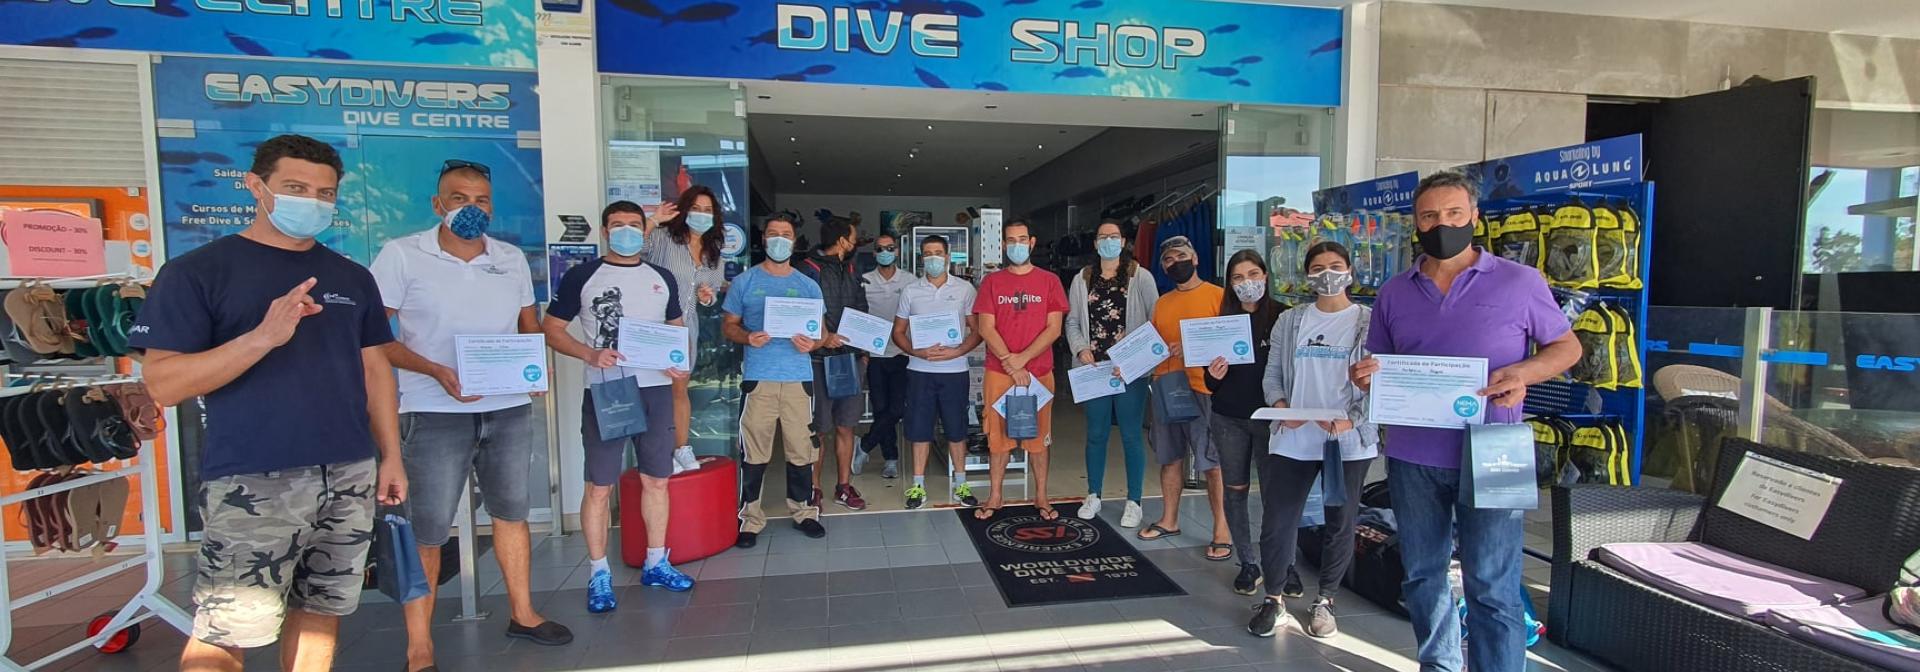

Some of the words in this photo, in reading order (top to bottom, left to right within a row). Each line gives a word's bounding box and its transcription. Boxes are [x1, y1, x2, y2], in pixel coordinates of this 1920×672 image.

[777, 4, 959, 58] DIVE
[1011, 18, 1207, 69] SHOP
[205, 73, 511, 110] EASYDIVERS
[343, 110, 400, 127] DIVE
[411, 112, 510, 129] CENTRE
[1535, 169, 1568, 184] AQUA
[1592, 159, 1632, 176] LUNG
[191, 204, 228, 213] Cursos
[230, 204, 243, 214] de
[181, 216, 206, 225] Free
[208, 216, 231, 225] Dive
[233, 216, 242, 225] &
[28, 246, 66, 254] DISCOUNT
[998, 295, 1019, 305] Dive
[1856, 354, 1920, 371] EAS
[1000, 555, 1137, 571] WORLDWIDE
[1013, 566, 1067, 578] DIVE
[1072, 563, 1135, 574] TEAM
[1105, 571, 1139, 579] 1970
